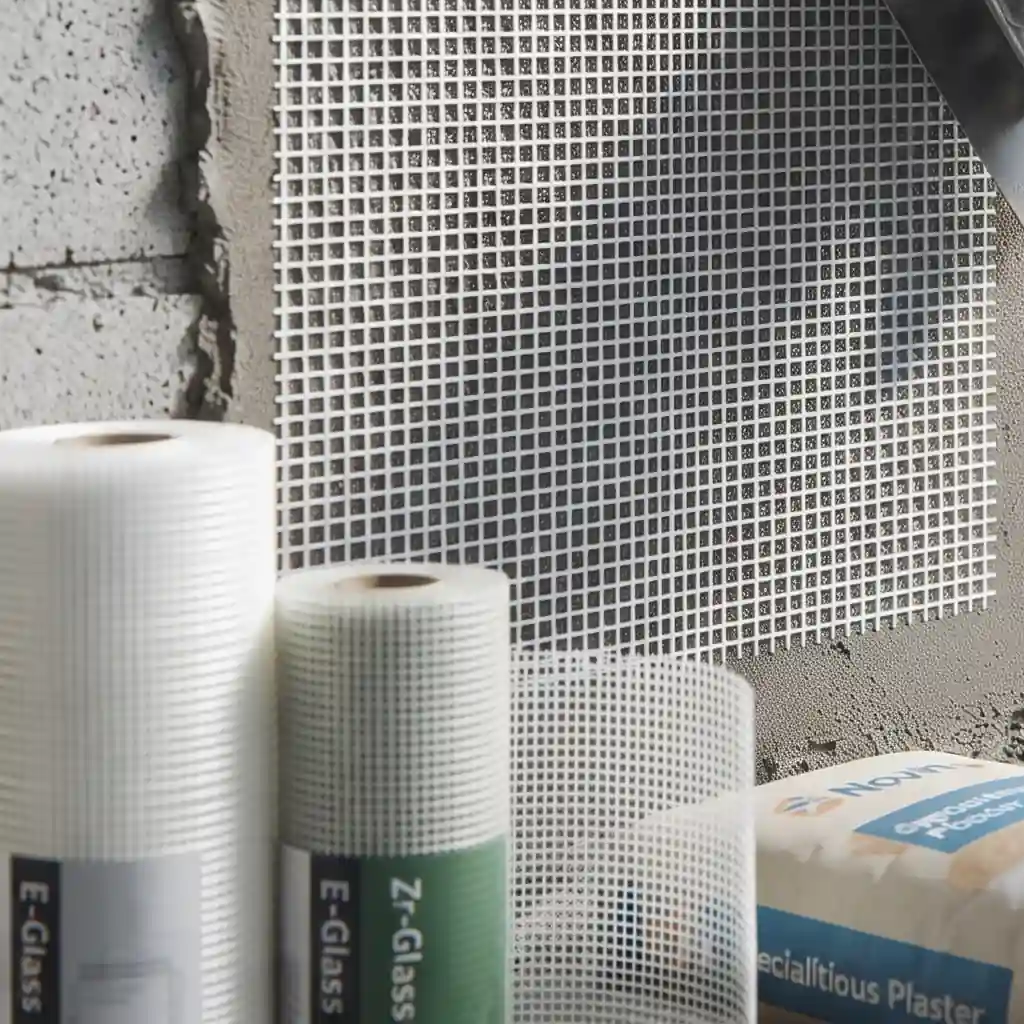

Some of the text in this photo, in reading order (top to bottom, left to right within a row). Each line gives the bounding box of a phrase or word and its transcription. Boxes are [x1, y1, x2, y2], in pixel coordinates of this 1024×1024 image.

[20, 880, 50, 1013] E-Glass
[320, 879, 350, 1014] E-Glass
[391, 877, 423, 1022] Zr-Glass
[888, 978, 987, 1024] Plaster
